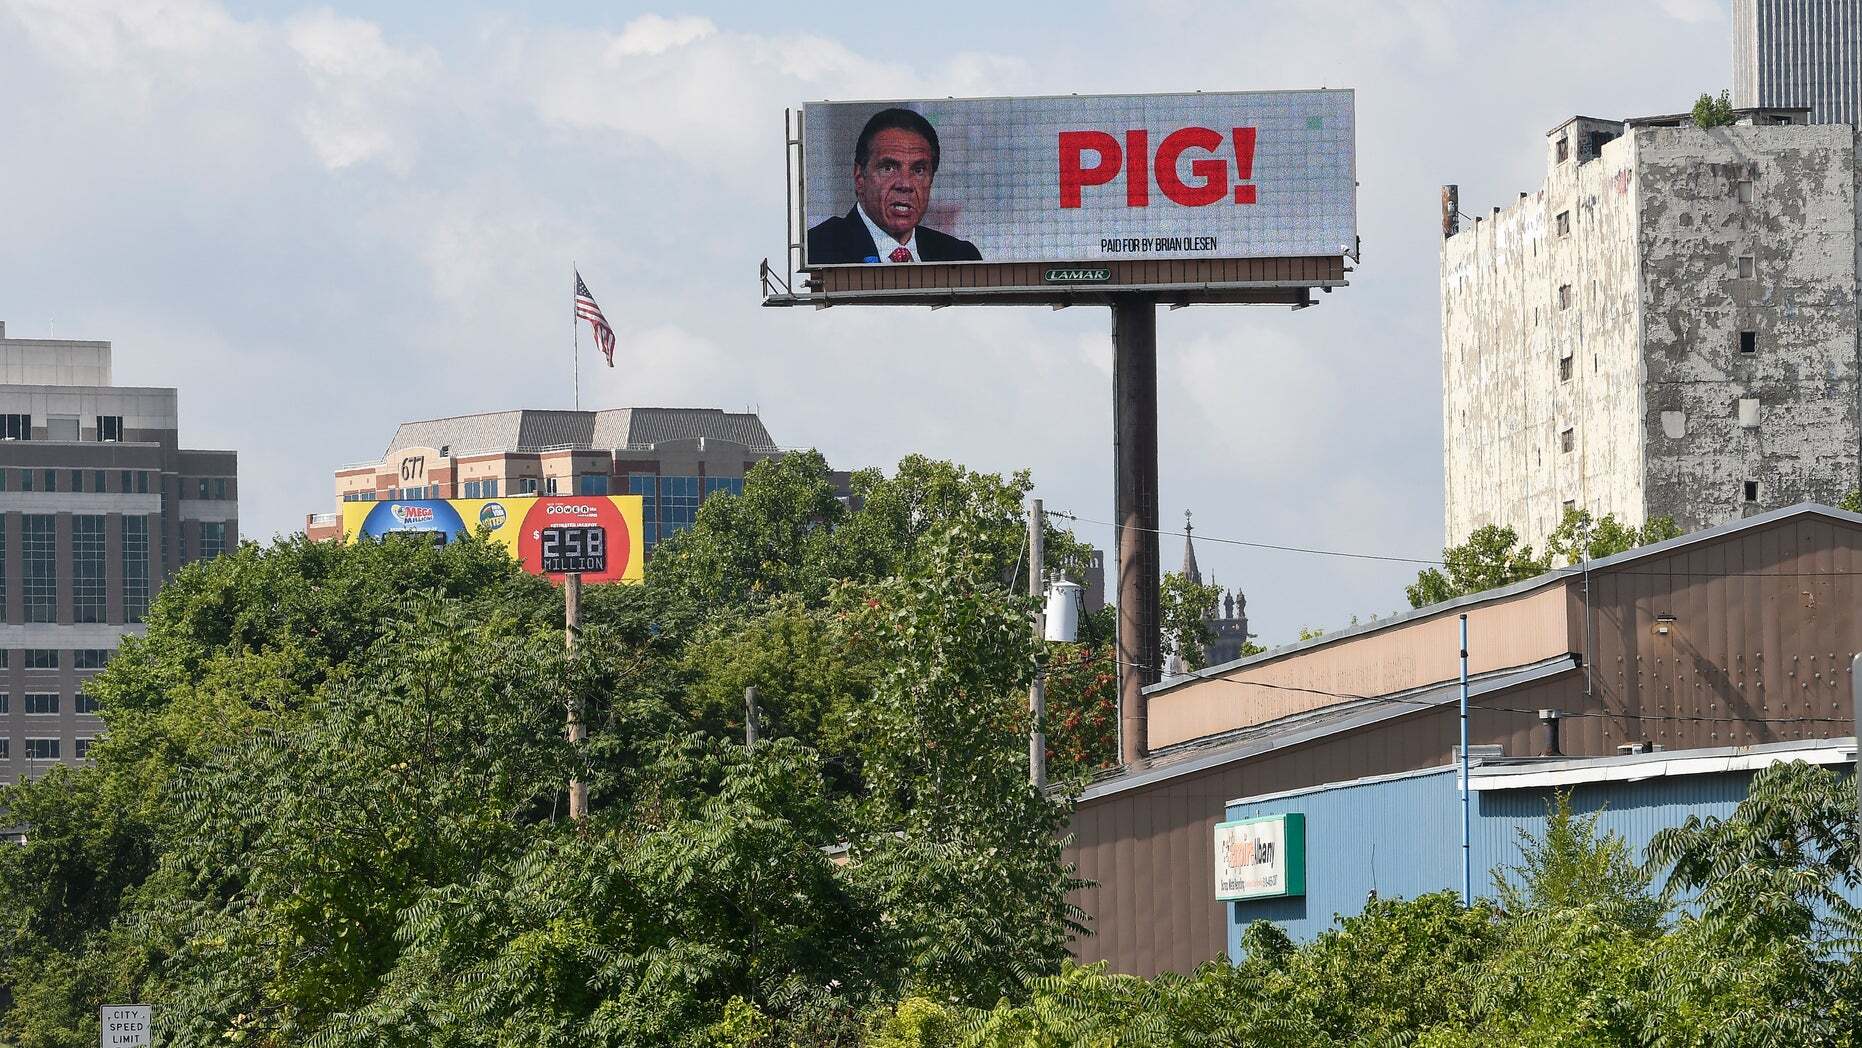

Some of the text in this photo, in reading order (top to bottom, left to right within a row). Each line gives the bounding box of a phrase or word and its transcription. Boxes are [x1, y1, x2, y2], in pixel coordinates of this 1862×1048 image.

[1058, 126, 1257, 209] PIG!
[1100, 236, 1217, 253] PAID FOR BY BRIAN OLESEN
[1050, 270, 1105, 280] LAMAR
[402, 456, 424, 480] 677
[404, 506, 433, 518] MEGA
[546, 504, 590, 515] POWER
[543, 529, 603, 558] 258
[544, 557, 604, 570] MILLION
[113, 1011, 138, 1019] CITY
[110, 1023, 143, 1031] SPEED
[112, 1035, 140, 1043] LIMIT
